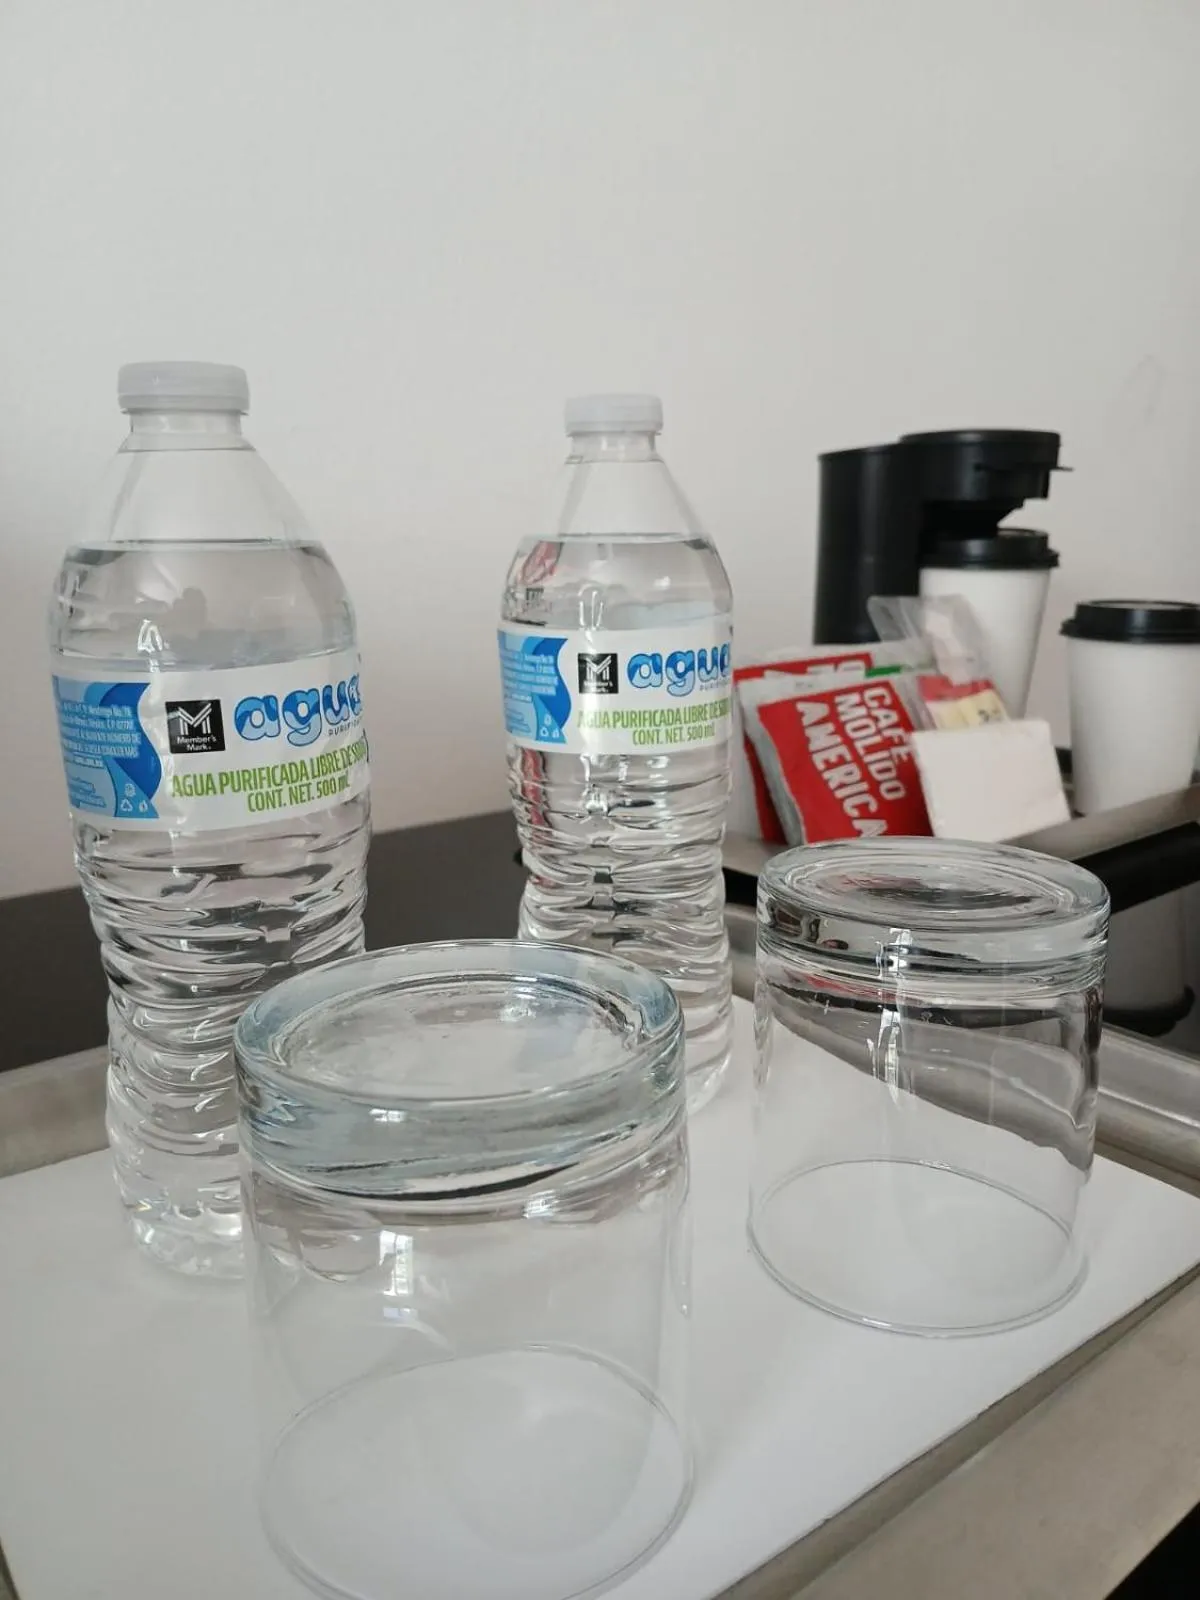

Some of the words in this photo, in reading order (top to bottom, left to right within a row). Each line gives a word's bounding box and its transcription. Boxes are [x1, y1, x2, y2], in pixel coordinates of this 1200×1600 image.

[612, 707, 682, 728] PURIFICADA
[683, 703, 708, 724] LIBRE
[177, 735, 217, 744] Member's
[632, 727, 665, 745] CONT.
[835, 693, 906, 801] MOLIDO
[172, 772, 217, 798] AGUA
[218, 759, 309, 795] PURIFICADA
[310, 750, 342, 780] LIBRE
[340, 745, 353, 770] DE
[247, 788, 288, 812] CONT.
[288, 782, 316, 805] NET.
[316, 778, 337, 800] 500
